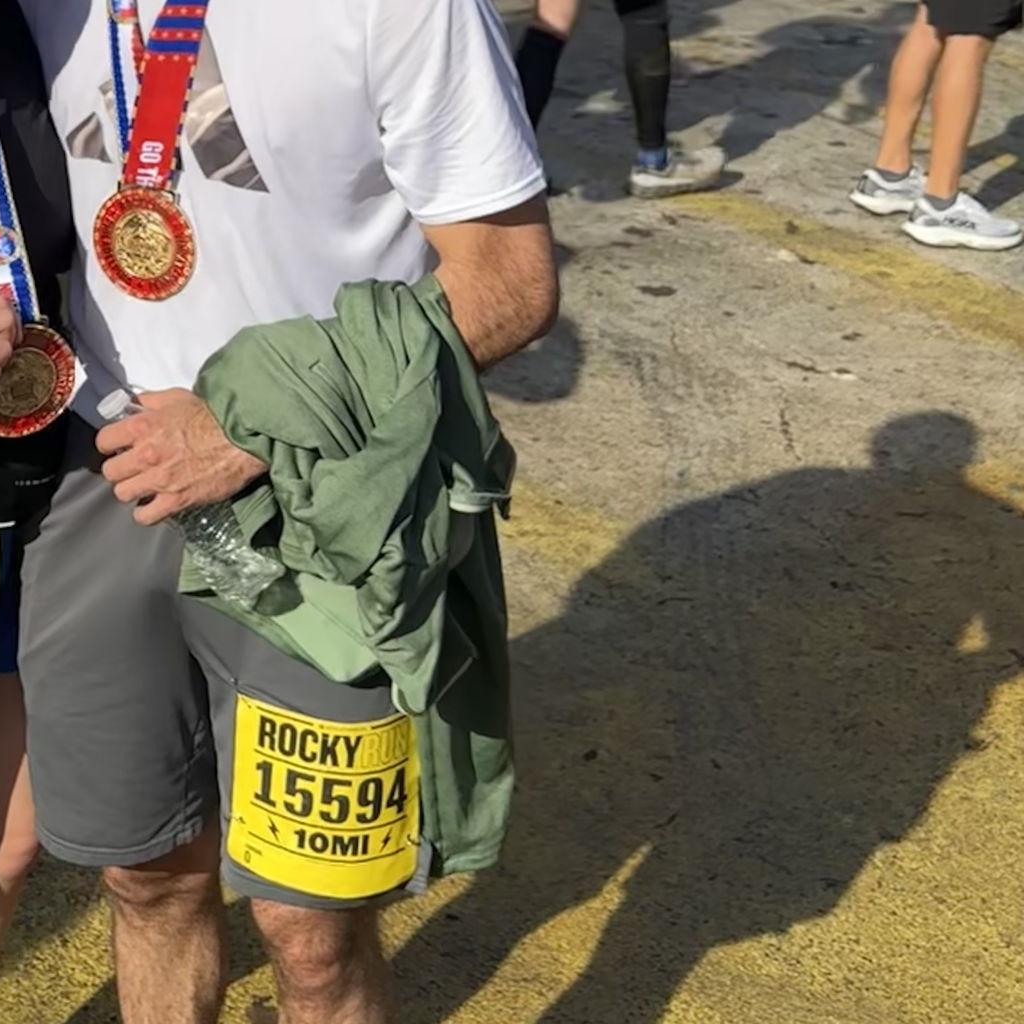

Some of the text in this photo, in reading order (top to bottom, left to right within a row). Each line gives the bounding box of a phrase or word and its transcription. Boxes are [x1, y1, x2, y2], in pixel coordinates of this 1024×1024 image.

[139, 141, 164, 164] GO
[253, 760, 408, 824] 15594
[293, 828, 370, 857] 10MI
